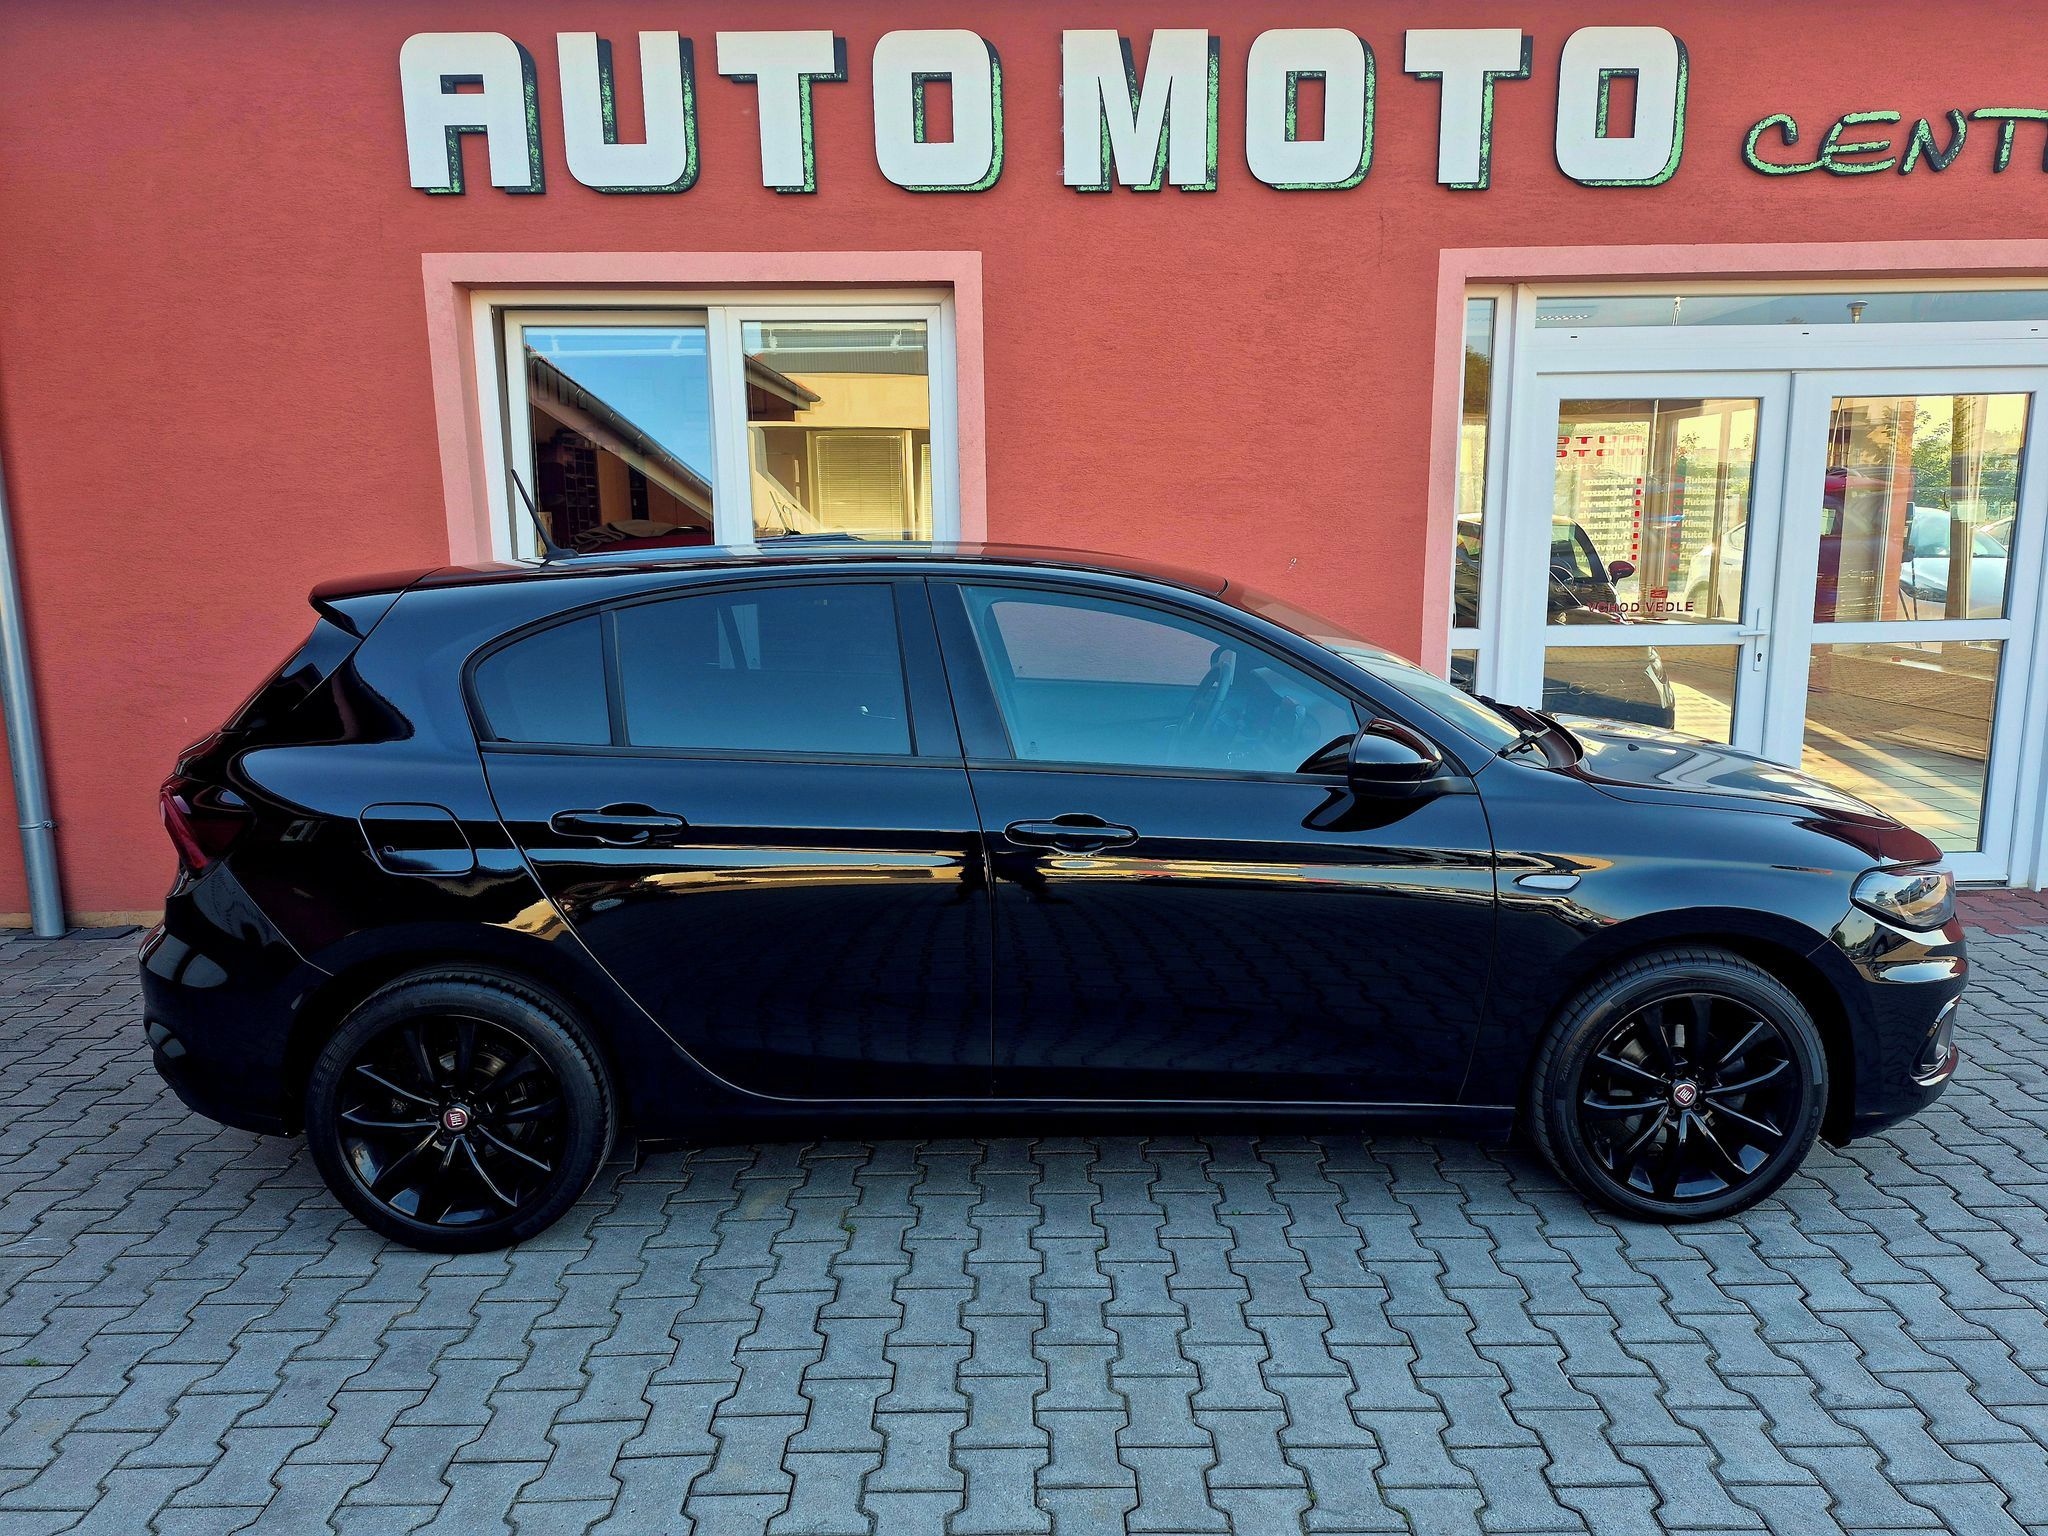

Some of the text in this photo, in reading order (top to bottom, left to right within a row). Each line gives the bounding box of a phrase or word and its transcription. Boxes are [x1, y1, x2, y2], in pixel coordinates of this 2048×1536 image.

[399, 26, 2048, 195] AUTO MOTO CENT
[1586, 601, 1694, 613] VCHOD VEDLE
